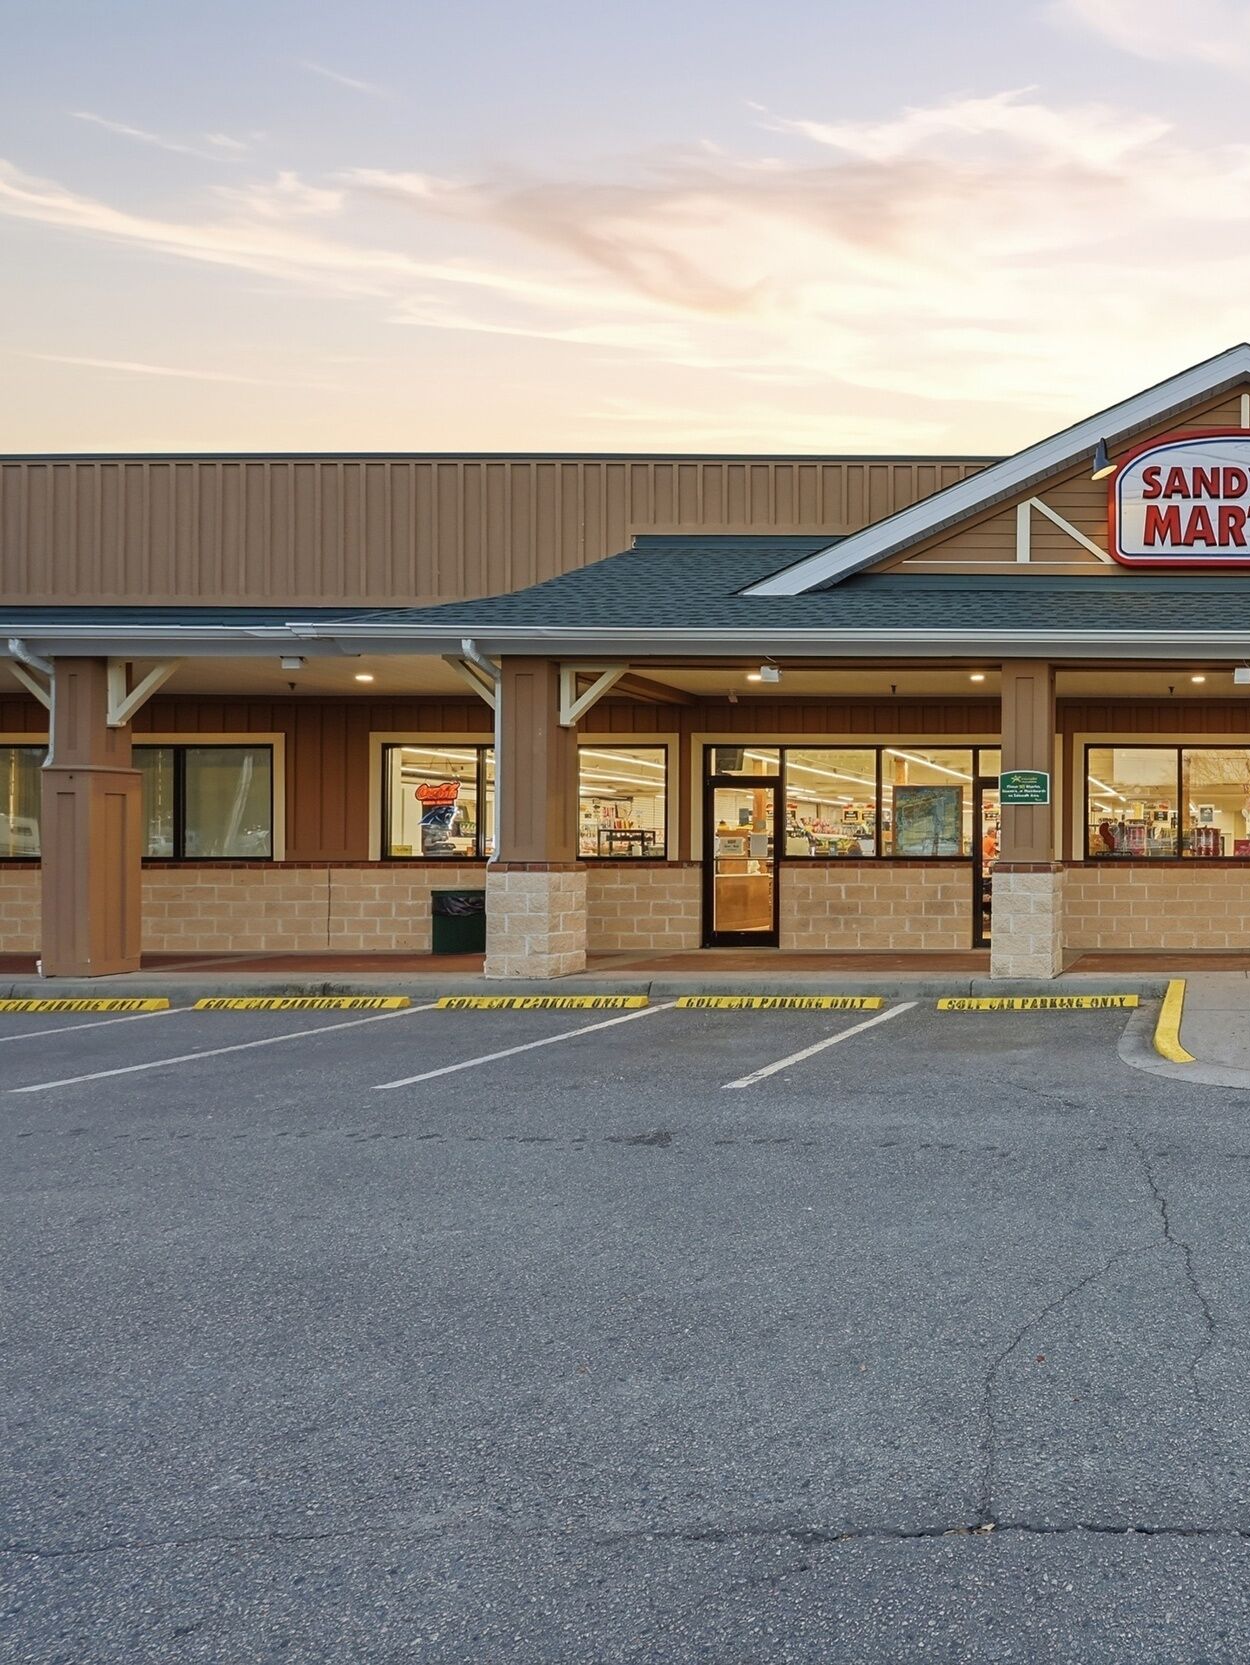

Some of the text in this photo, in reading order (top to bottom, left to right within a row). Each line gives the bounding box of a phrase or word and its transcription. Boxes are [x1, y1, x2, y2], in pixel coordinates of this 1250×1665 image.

[34, 1000, 103, 1011] PARKING
[106, 1000, 148, 1010] ONLY
[277, 999, 345, 1009] PARKING
[349, 999, 389, 1008] ONLY
[520, 999, 584, 1008] PARKING
[591, 998, 630, 1008] ONLY
[760, 999, 823, 1008] PARKING
[829, 999, 867, 1008] ONLY
[1021, 999, 1083, 1008] PARKING
[1090, 997, 1126, 1007] ONLY
